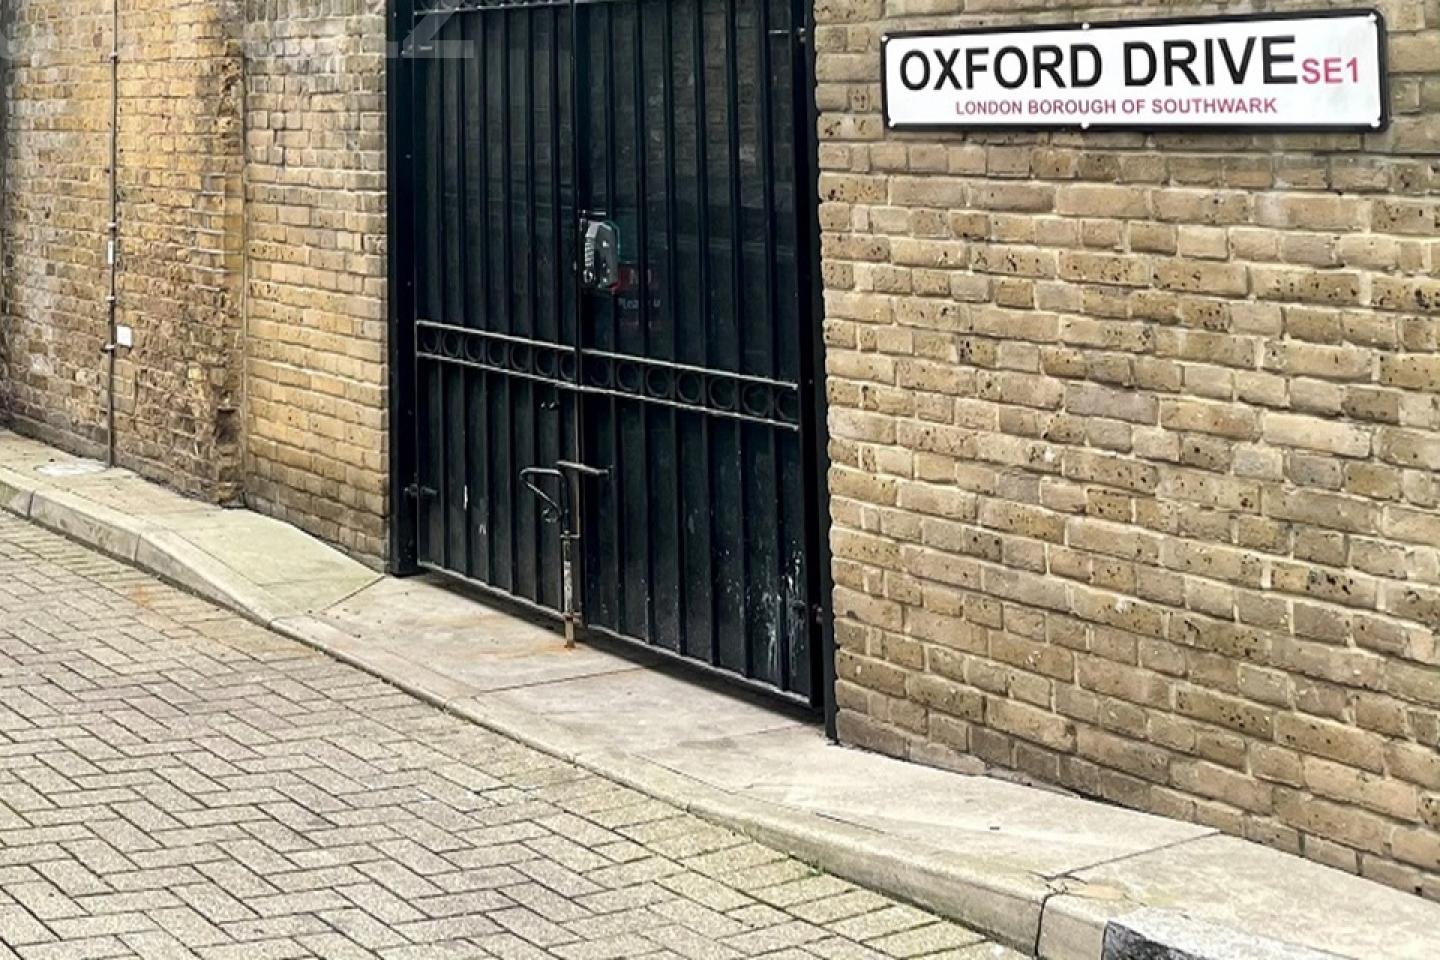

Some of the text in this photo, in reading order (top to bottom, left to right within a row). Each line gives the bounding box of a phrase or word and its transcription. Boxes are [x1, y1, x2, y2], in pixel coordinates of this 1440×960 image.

[899, 35, 1358, 91] OXFORD DRIVE SE1
[955, 97, 1277, 115] LONDON BOROUGH OF SOUTHWARK
